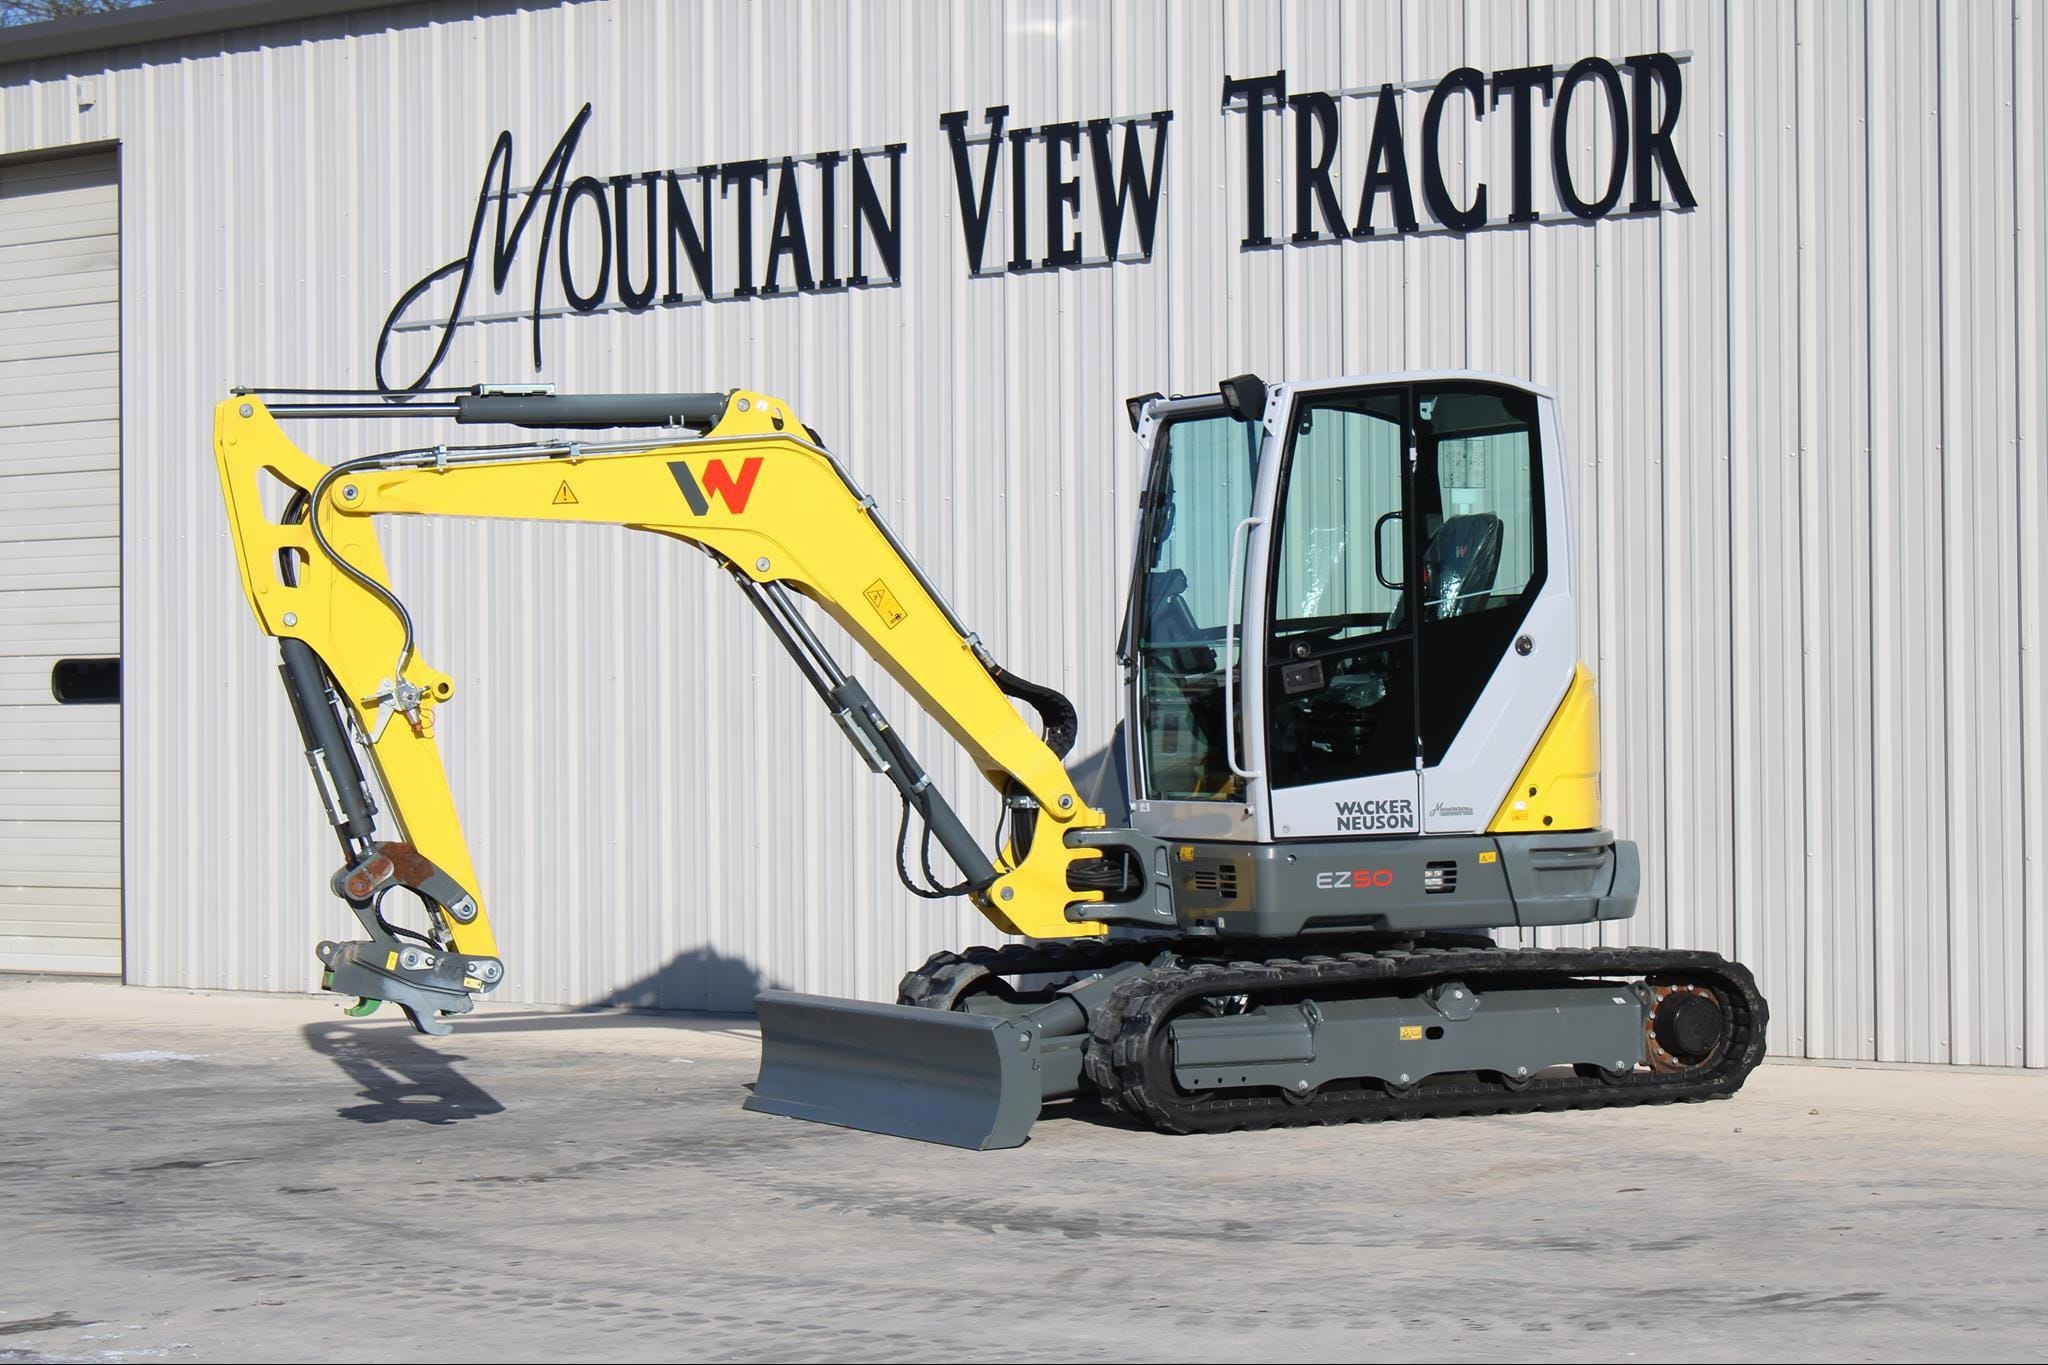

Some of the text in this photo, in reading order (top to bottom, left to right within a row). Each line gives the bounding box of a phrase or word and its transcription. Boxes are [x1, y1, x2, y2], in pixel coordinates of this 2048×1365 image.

[375, 52, 1697, 394] MOUNTAIN VIEW TRACTOR
[1335, 799, 1413, 816] WACKER
[1337, 815, 1413, 831] NEUSON
[1316, 868, 1393, 889] EZ50
